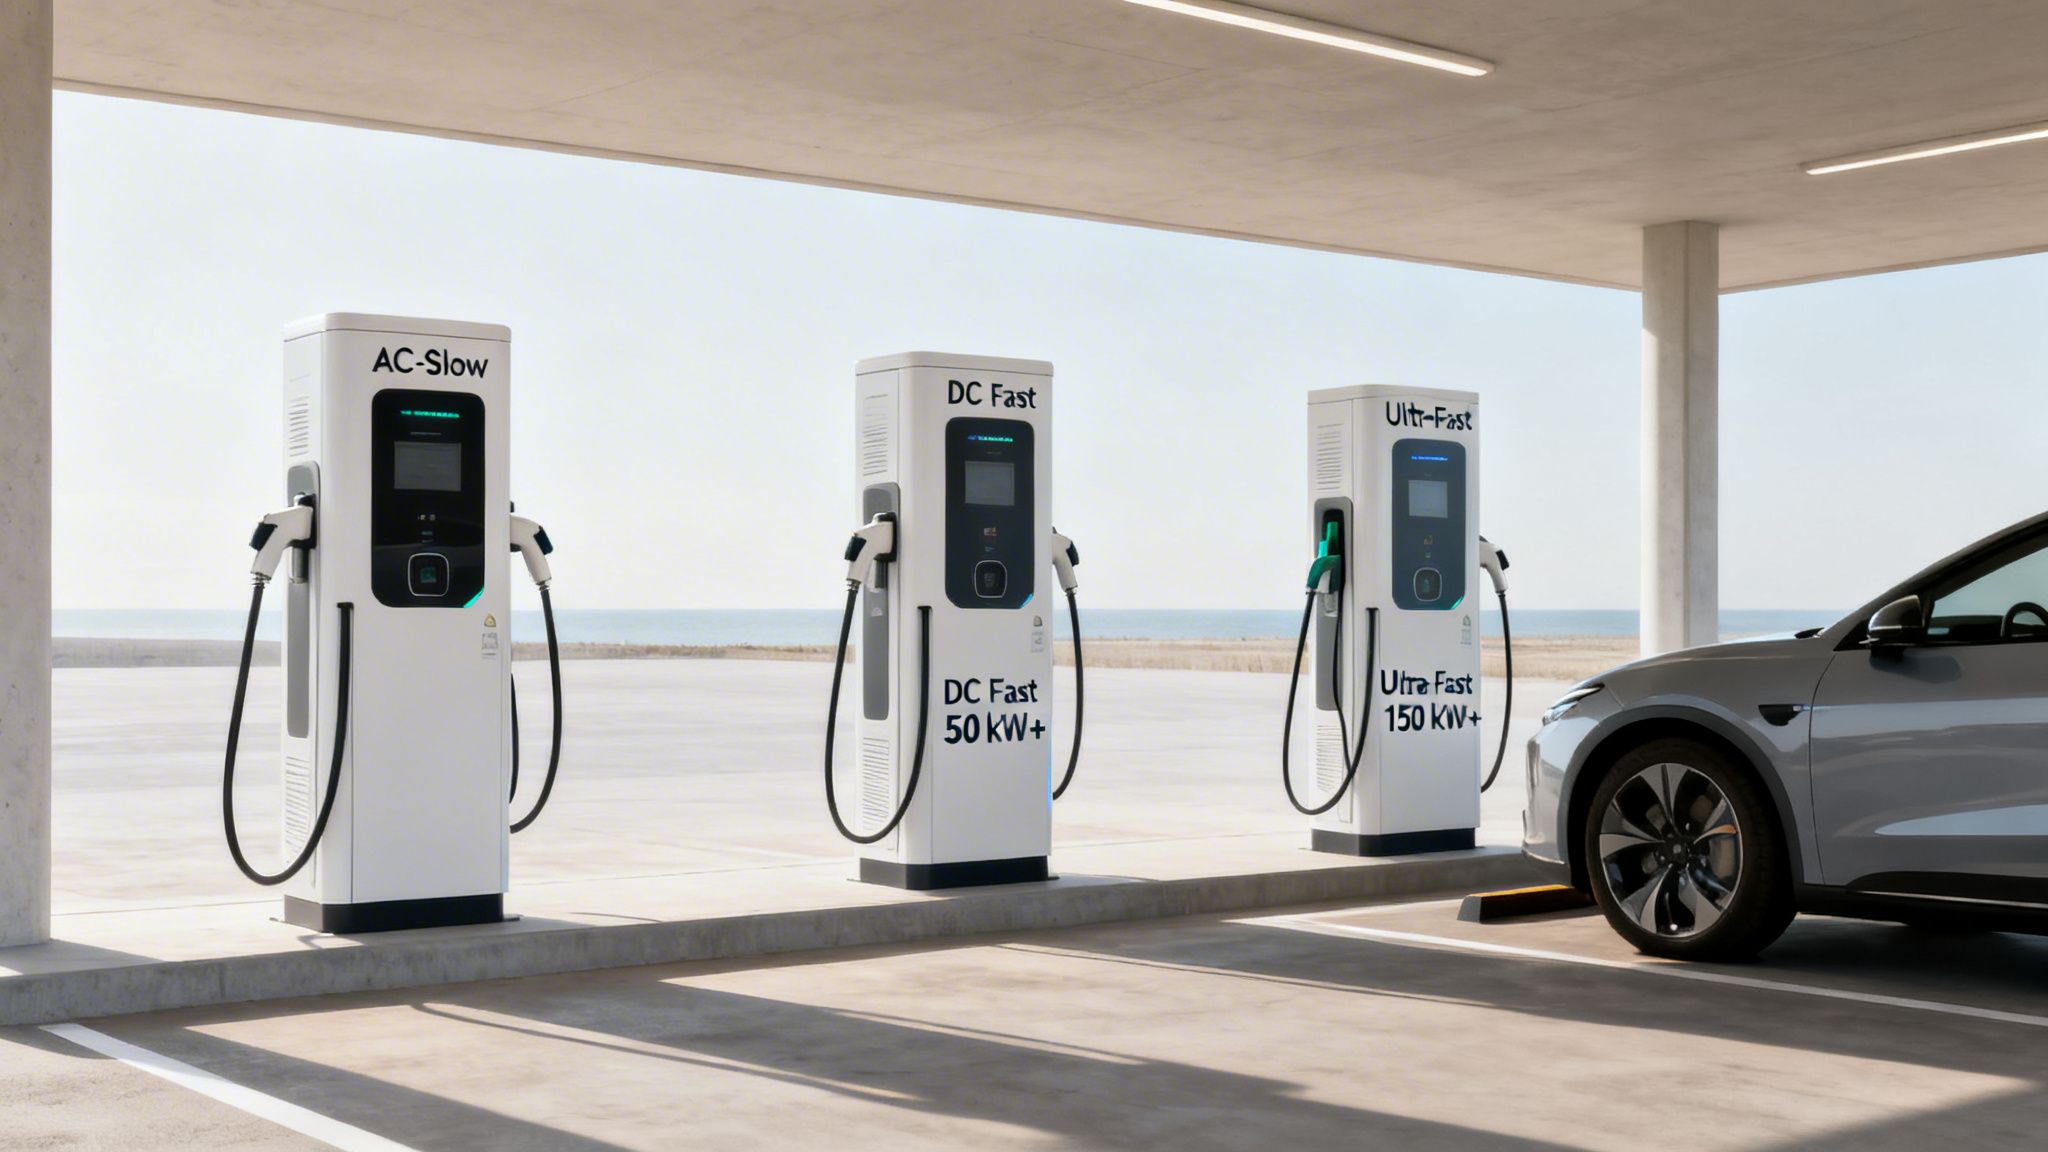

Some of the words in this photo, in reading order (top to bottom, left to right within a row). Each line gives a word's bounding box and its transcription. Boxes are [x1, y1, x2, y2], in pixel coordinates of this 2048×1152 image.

[372, 346, 489, 378] AC-Slow
[947, 379, 982, 406] DC
[991, 382, 1037, 409] Fast
[944, 678, 982, 705] DC
[989, 677, 1038, 704] Fast
[1434, 670, 1473, 695] Fast
[944, 713, 980, 744] 50
[1384, 703, 1425, 732] 150
